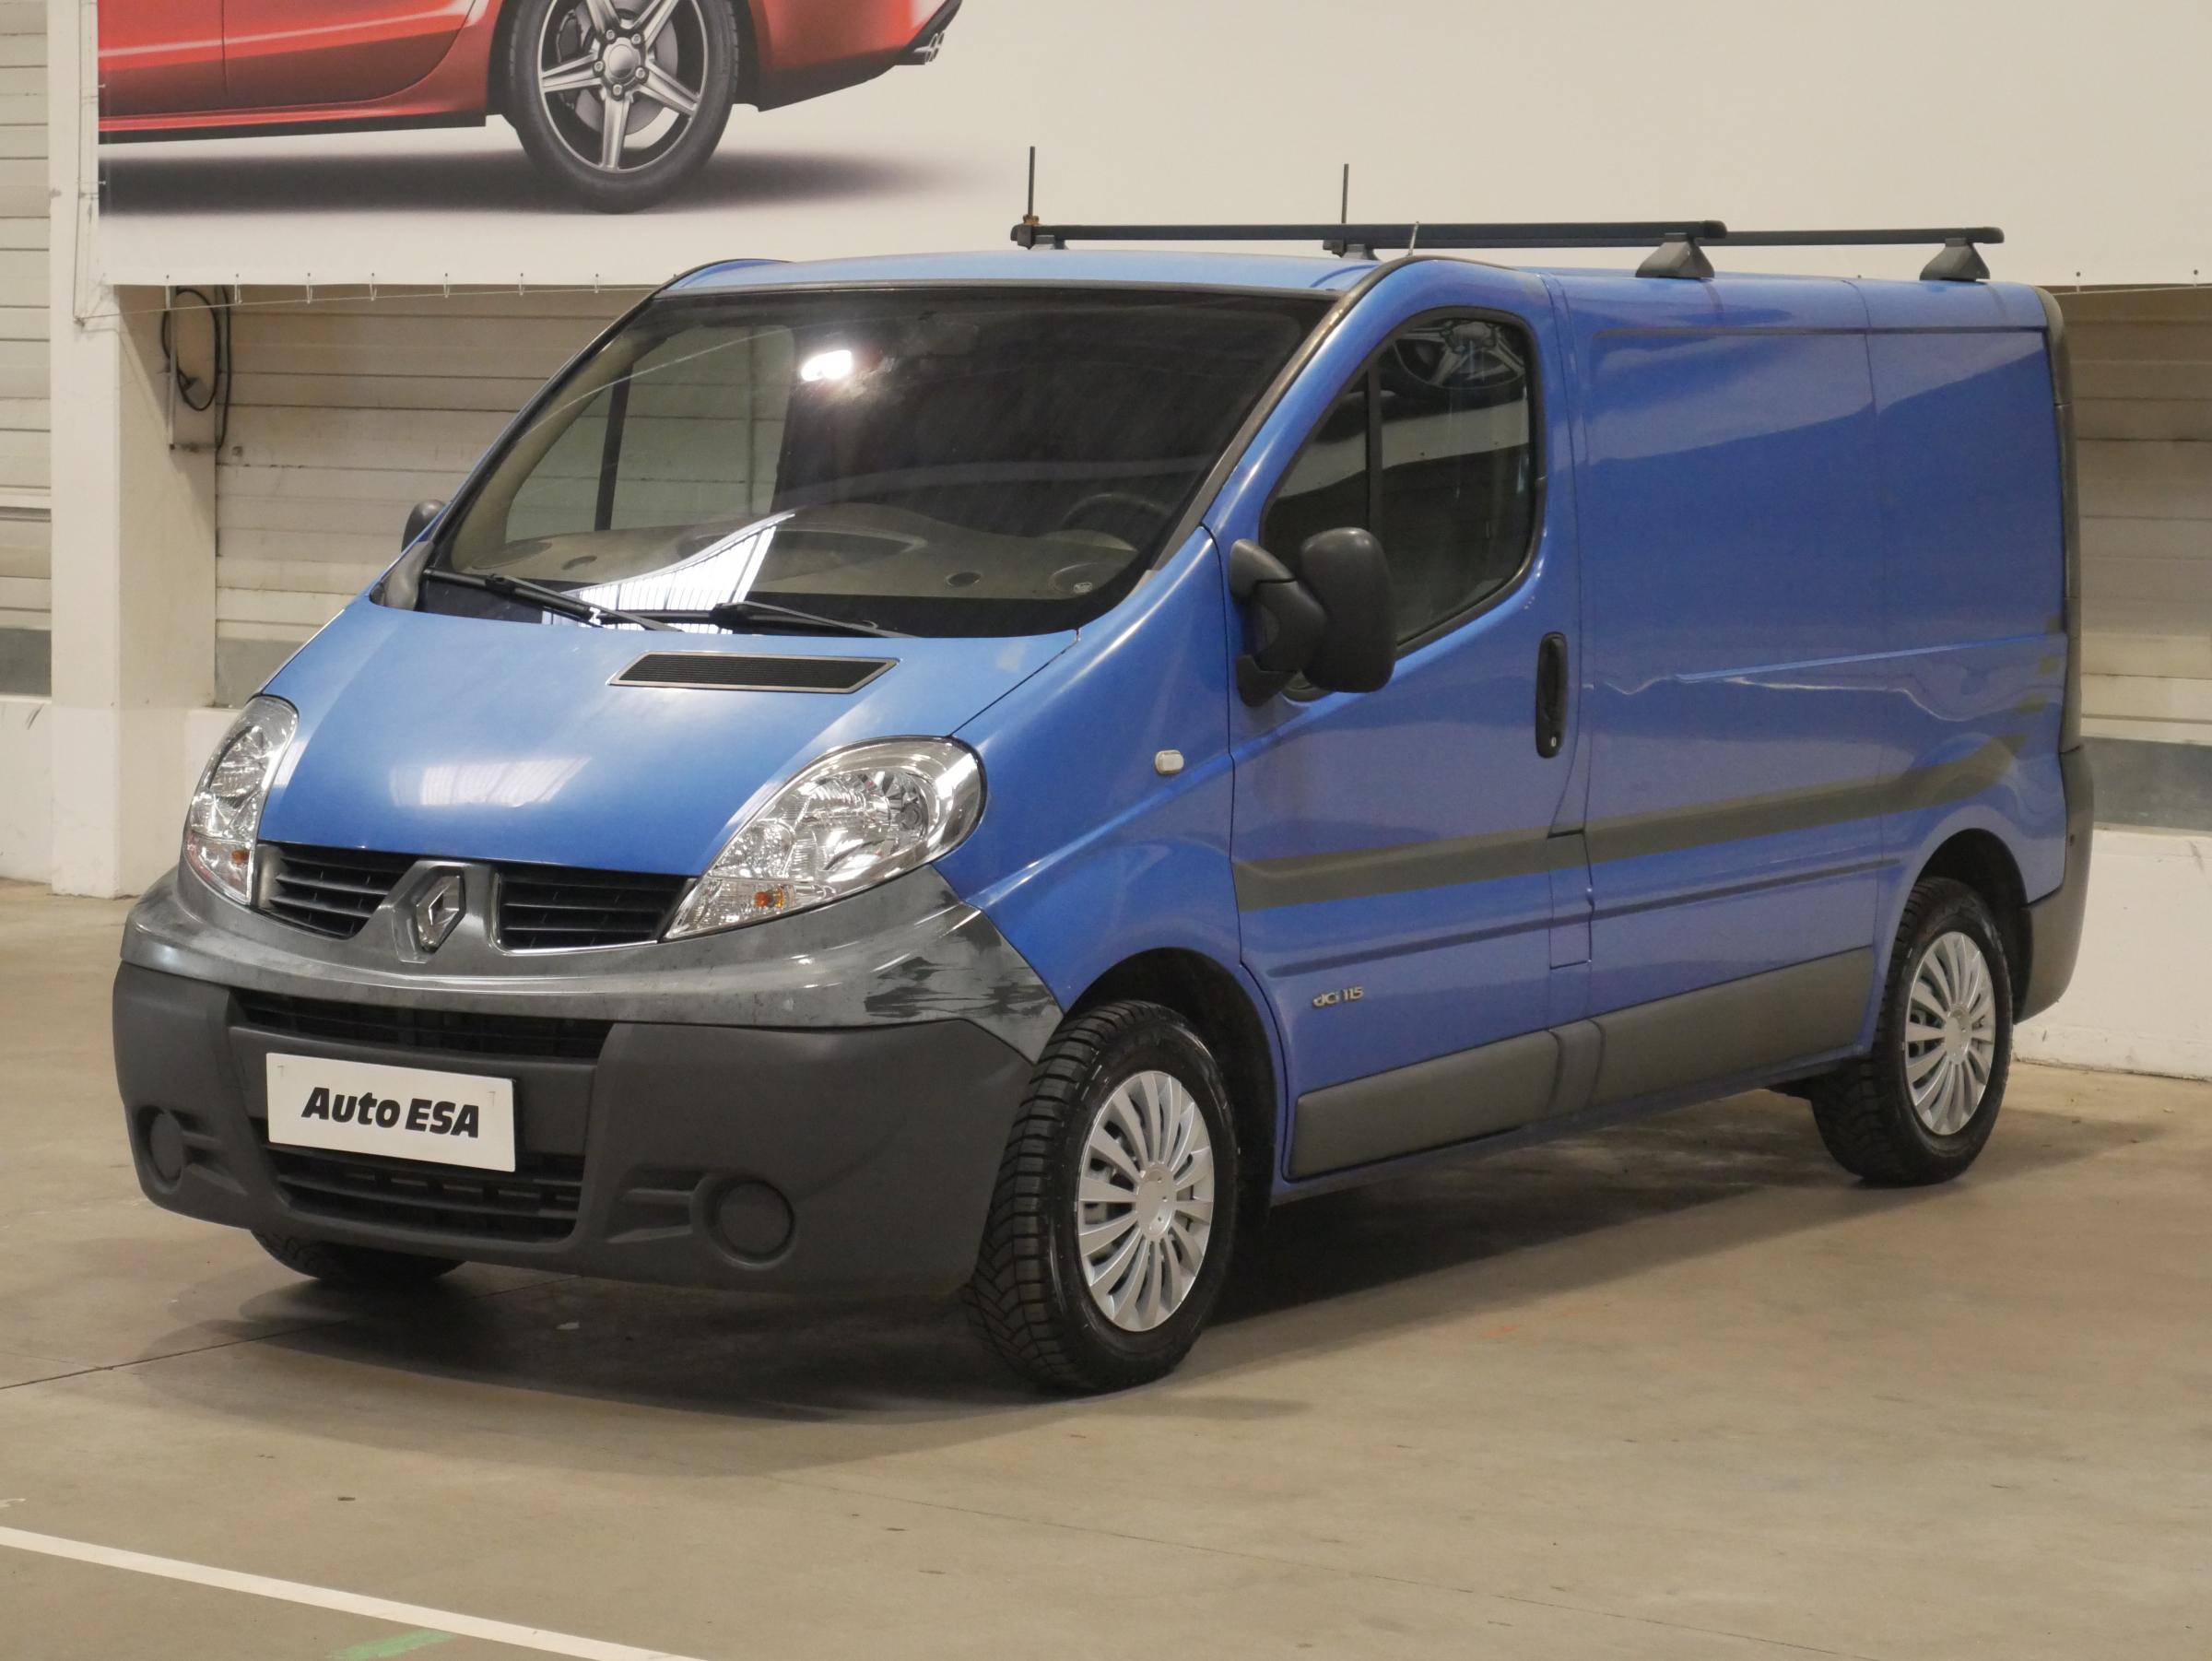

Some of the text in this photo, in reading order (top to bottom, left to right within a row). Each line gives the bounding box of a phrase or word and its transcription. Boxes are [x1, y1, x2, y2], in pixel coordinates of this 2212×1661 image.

[1342, 986, 1364, 1001] 115
[300, 1086, 479, 1138] Auto ESA
